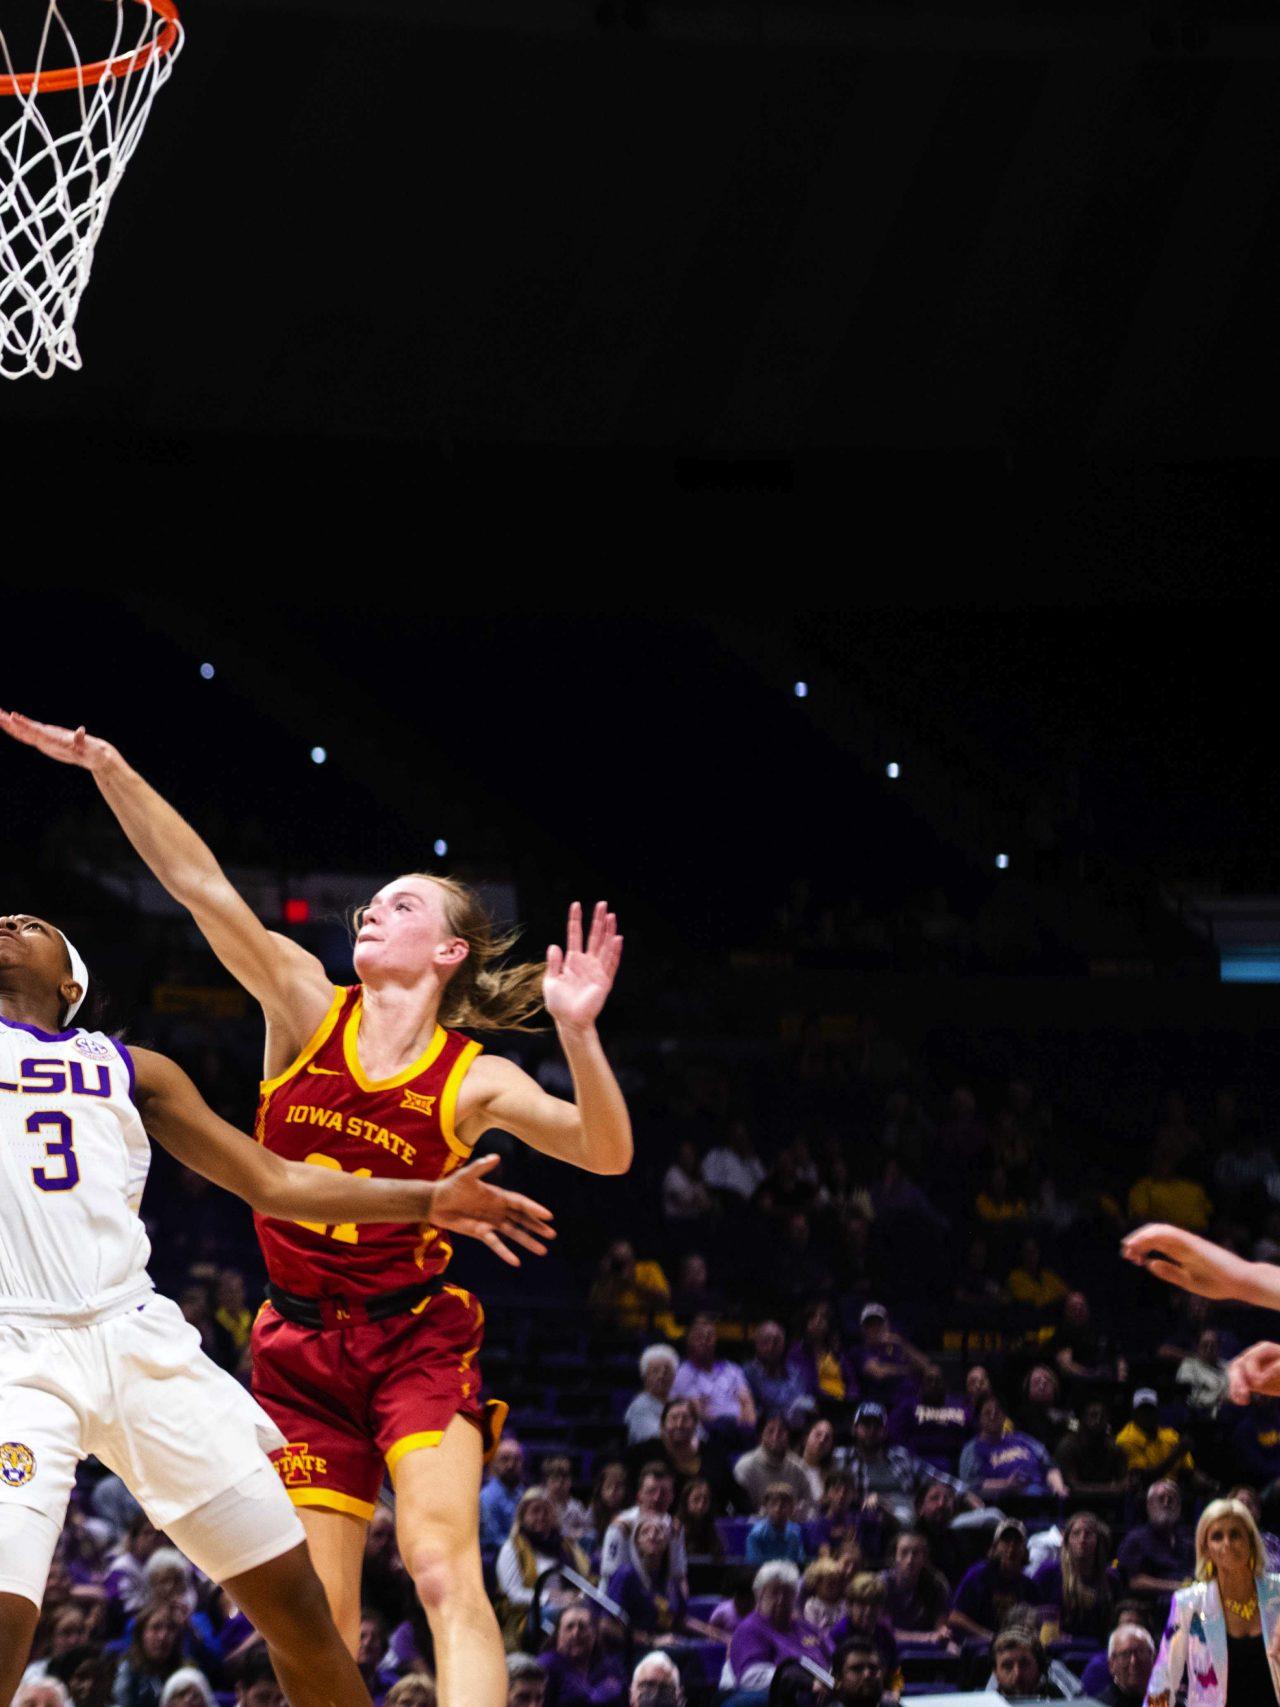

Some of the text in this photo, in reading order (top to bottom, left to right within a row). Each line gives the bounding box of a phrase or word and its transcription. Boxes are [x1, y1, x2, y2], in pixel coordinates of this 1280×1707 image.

[26, 1110, 80, 1191] 3
[285, 1105, 417, 1166] IOWA STATE
